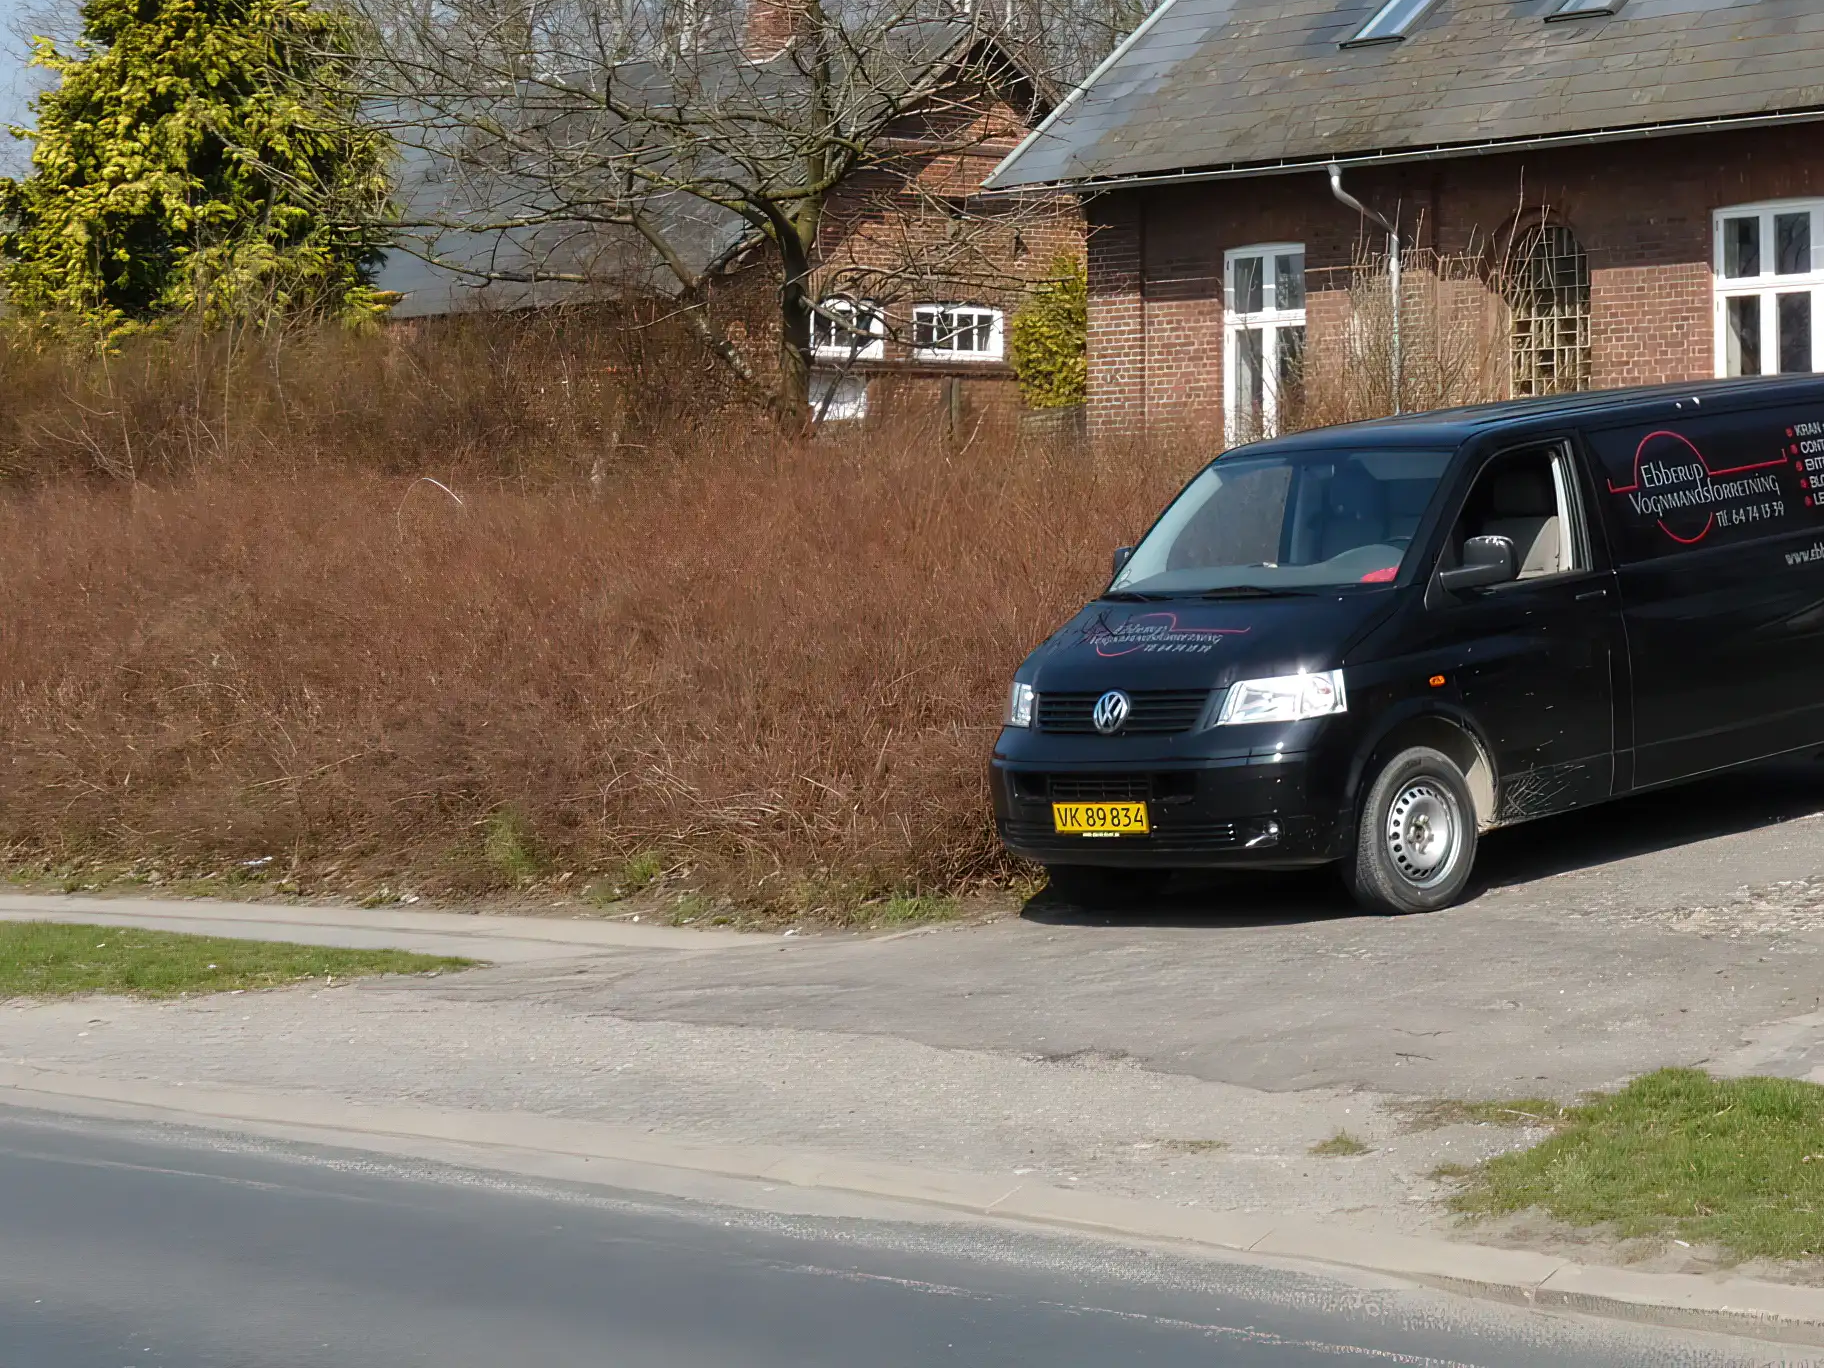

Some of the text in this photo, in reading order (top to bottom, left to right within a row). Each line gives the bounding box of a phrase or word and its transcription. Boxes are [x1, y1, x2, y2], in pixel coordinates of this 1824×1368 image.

[1794, 421, 1822, 437] KRAN
[1732, 508, 1746, 525] 64
[1746, 505, 1760, 522] 74
[1771, 500, 1785, 517] 39
[1056, 807, 1144, 828] VK 89 834
